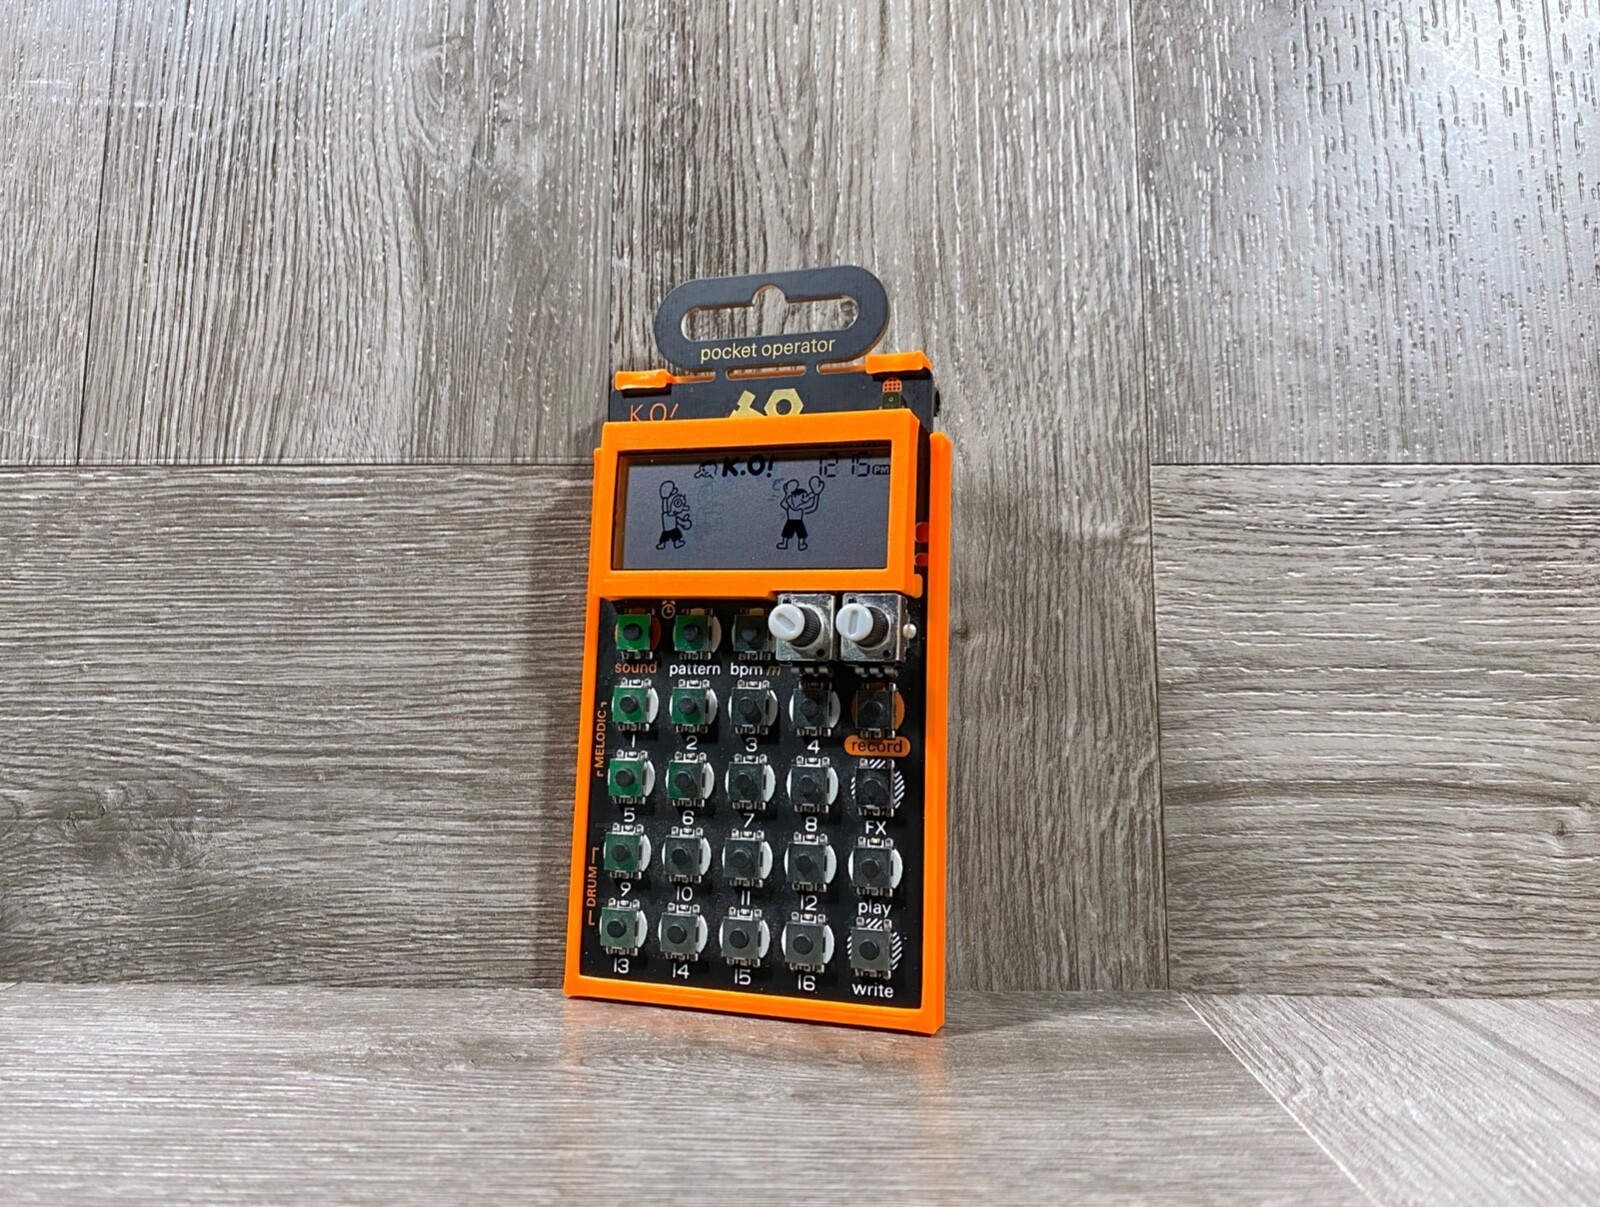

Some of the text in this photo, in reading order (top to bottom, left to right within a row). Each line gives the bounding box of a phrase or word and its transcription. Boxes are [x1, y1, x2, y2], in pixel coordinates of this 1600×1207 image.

[701, 337, 836, 364] pocket operator
[722, 455, 776, 478] K.O!
[614, 661, 657, 675] sound
[669, 662, 721, 677] pattern
[730, 661, 763, 678] bpm
[594, 710, 607, 768] MELODIC
[685, 735, 698, 751] 2
[745, 737, 758, 753] 3
[807, 738, 820, 754] 4
[850, 740, 903, 754] record
[623, 809, 636, 823] 5
[682, 811, 694, 825] 6
[743, 813, 755, 828] 7
[805, 816, 818, 832] 8
[865, 820, 887, 835] FX
[586, 866, 598, 908] DRUM
[619, 882, 632, 897] 9
[676, 886, 693, 901] 10
[740, 890, 751, 905] 11
[800, 894, 818, 911] 12
[858, 901, 892, 917] play
[613, 958, 630, 974] 13
[672, 963, 690, 979] 14
[734, 969, 752, 985] 15
[797, 976, 816, 991] 16
[851, 982, 894, 999] write
